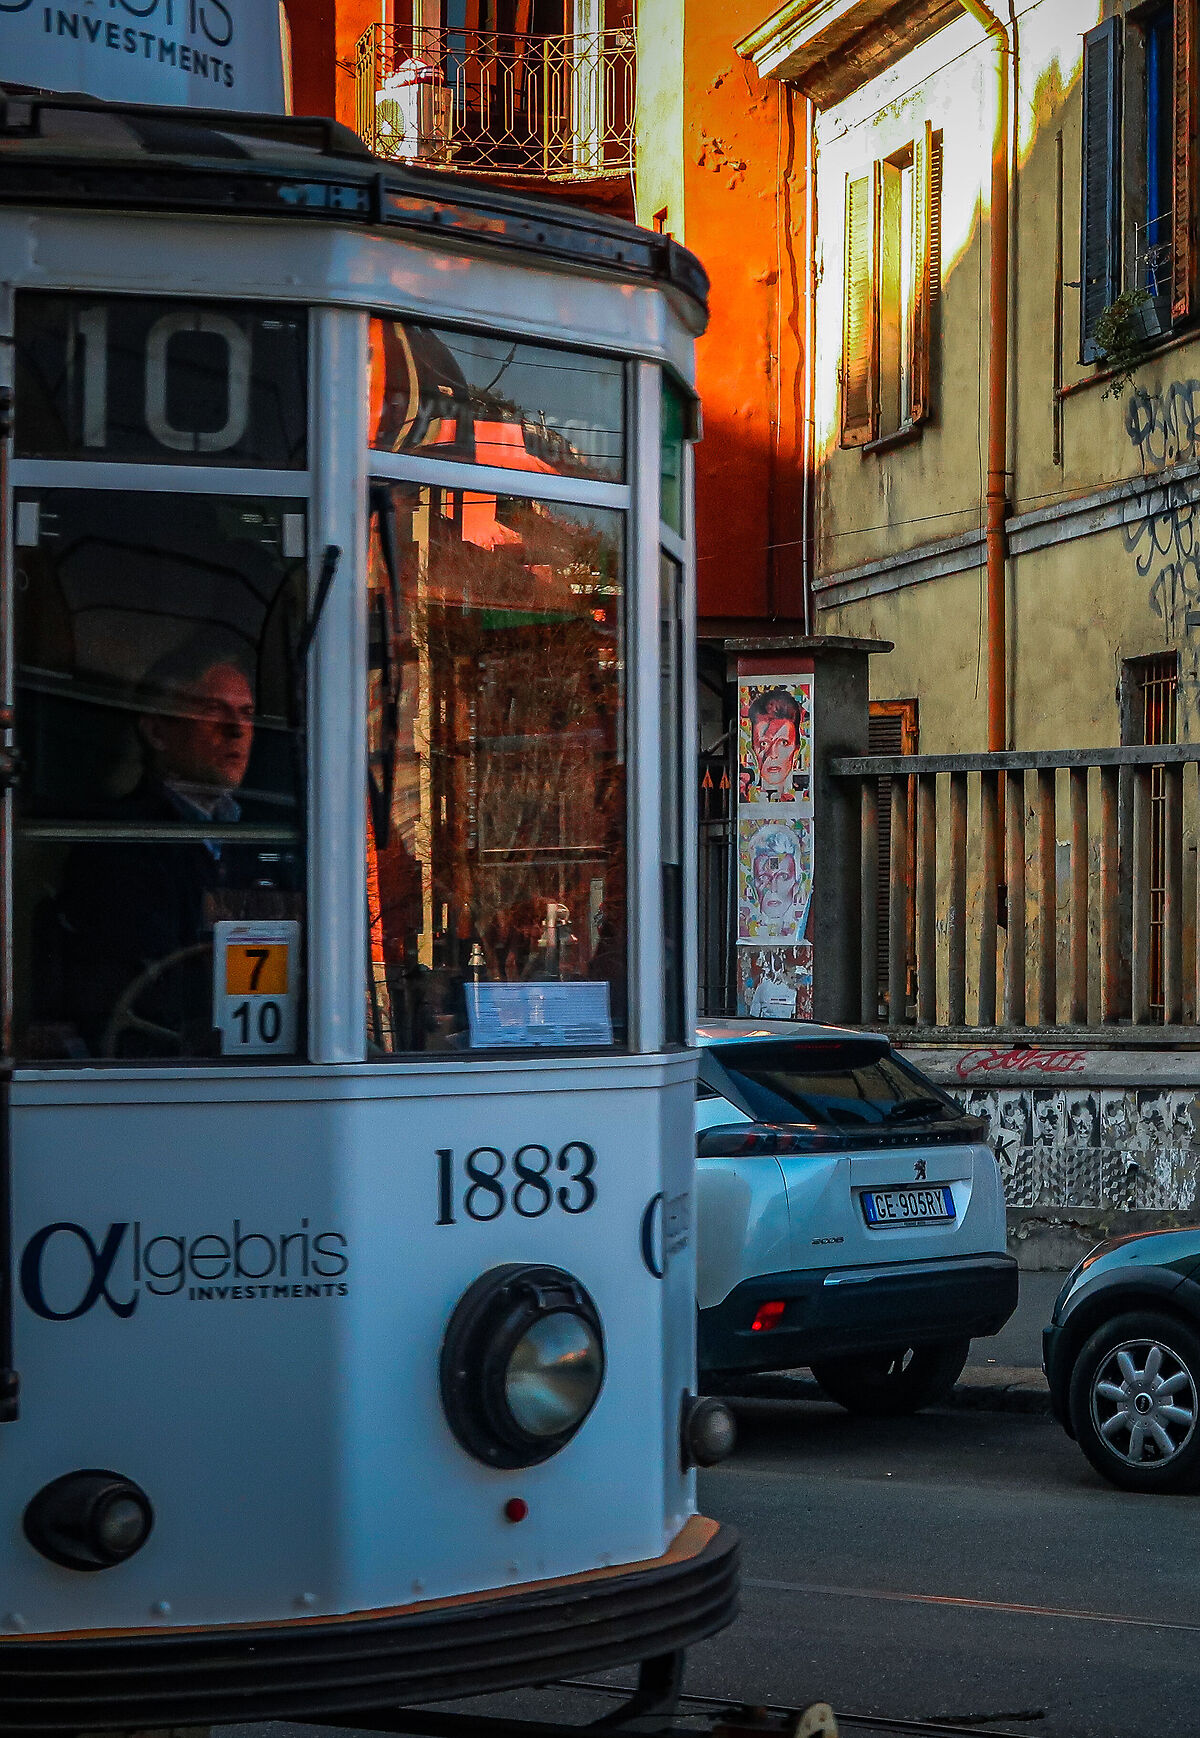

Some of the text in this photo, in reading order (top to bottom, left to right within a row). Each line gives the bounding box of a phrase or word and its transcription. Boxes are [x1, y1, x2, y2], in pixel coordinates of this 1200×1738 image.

[44, 7, 234, 88] INVESTMENTS
[78, 306, 251, 452] 10
[245, 949, 270, 991] 7
[232, 1001, 281, 1044] 10
[434, 1141, 598, 1225] 1883
[899, 1190, 944, 1217] 905RY
[188, 1283, 349, 1301] INVESTMENTS
